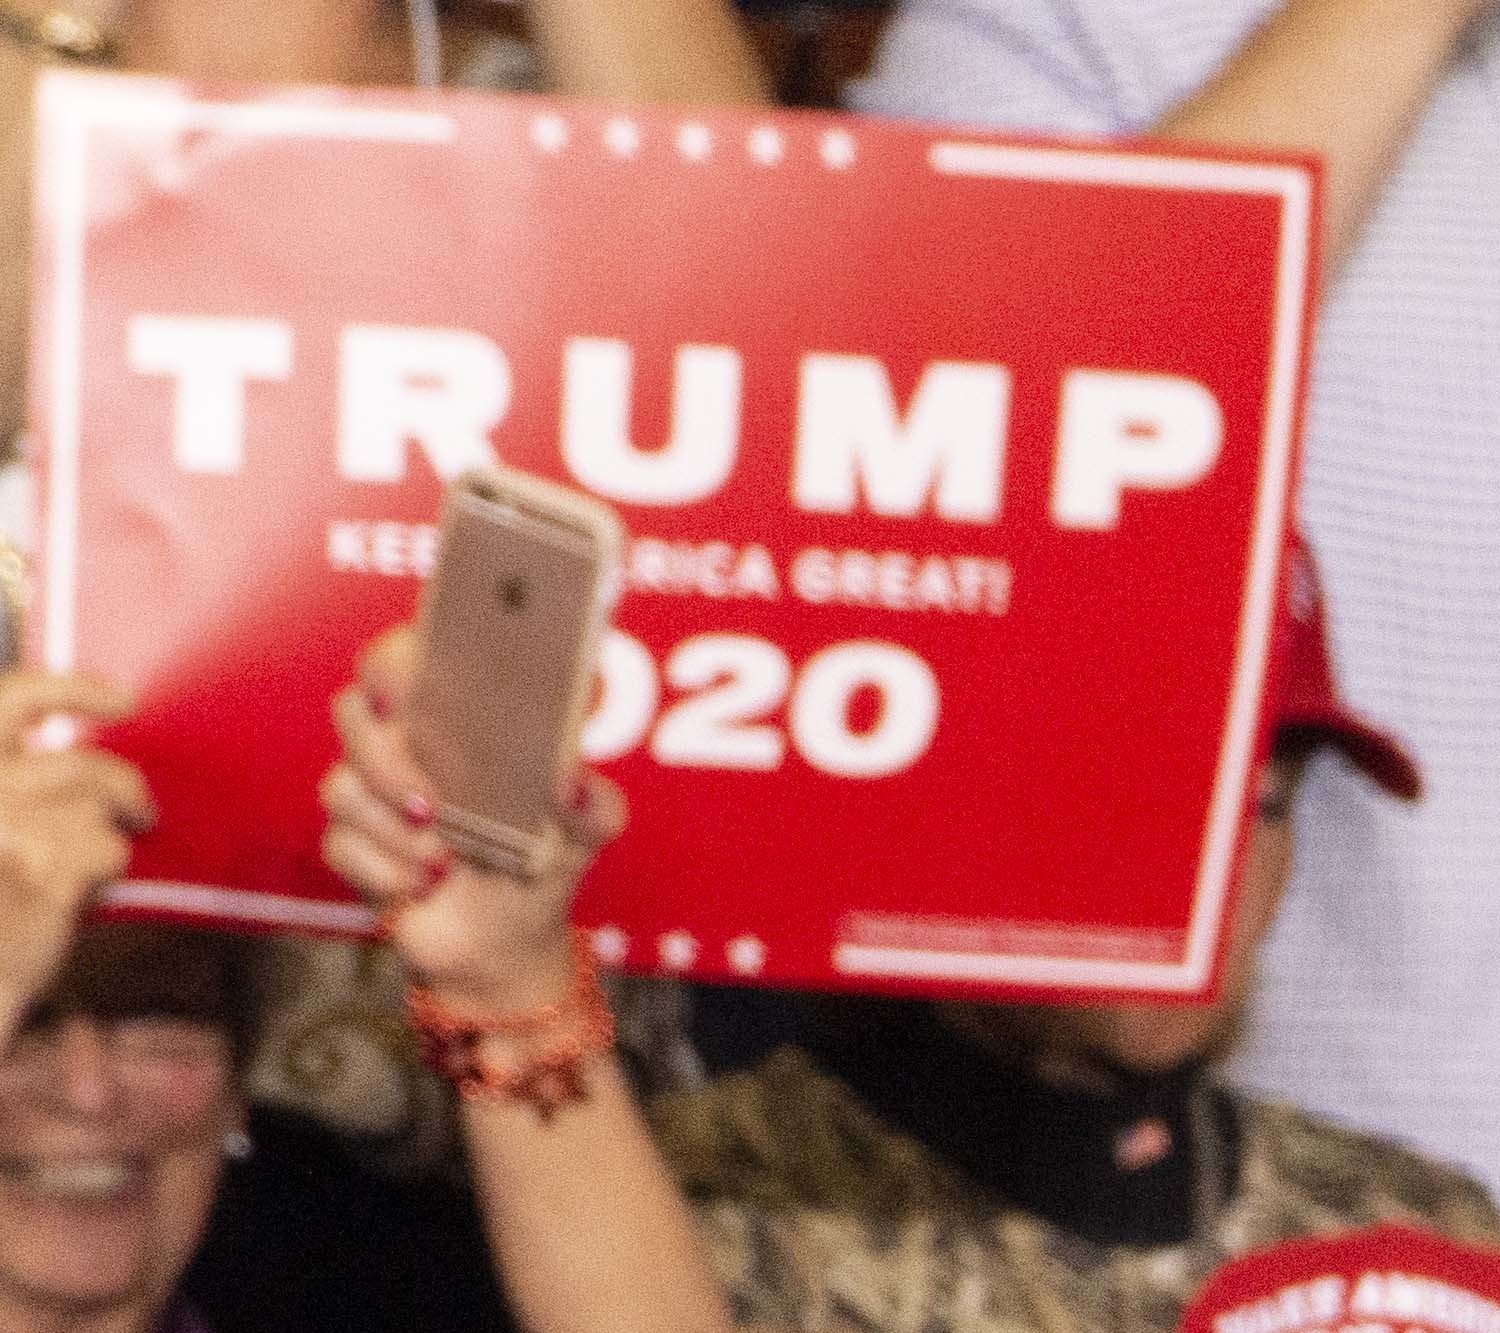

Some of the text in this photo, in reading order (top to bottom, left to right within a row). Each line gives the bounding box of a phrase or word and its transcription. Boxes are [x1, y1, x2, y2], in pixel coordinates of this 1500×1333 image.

[127, 312, 1223, 531] TRUMP
[326, 520, 438, 578] KEE
[628, 537, 779, 600] RICA
[582, 625, 940, 779] 020
